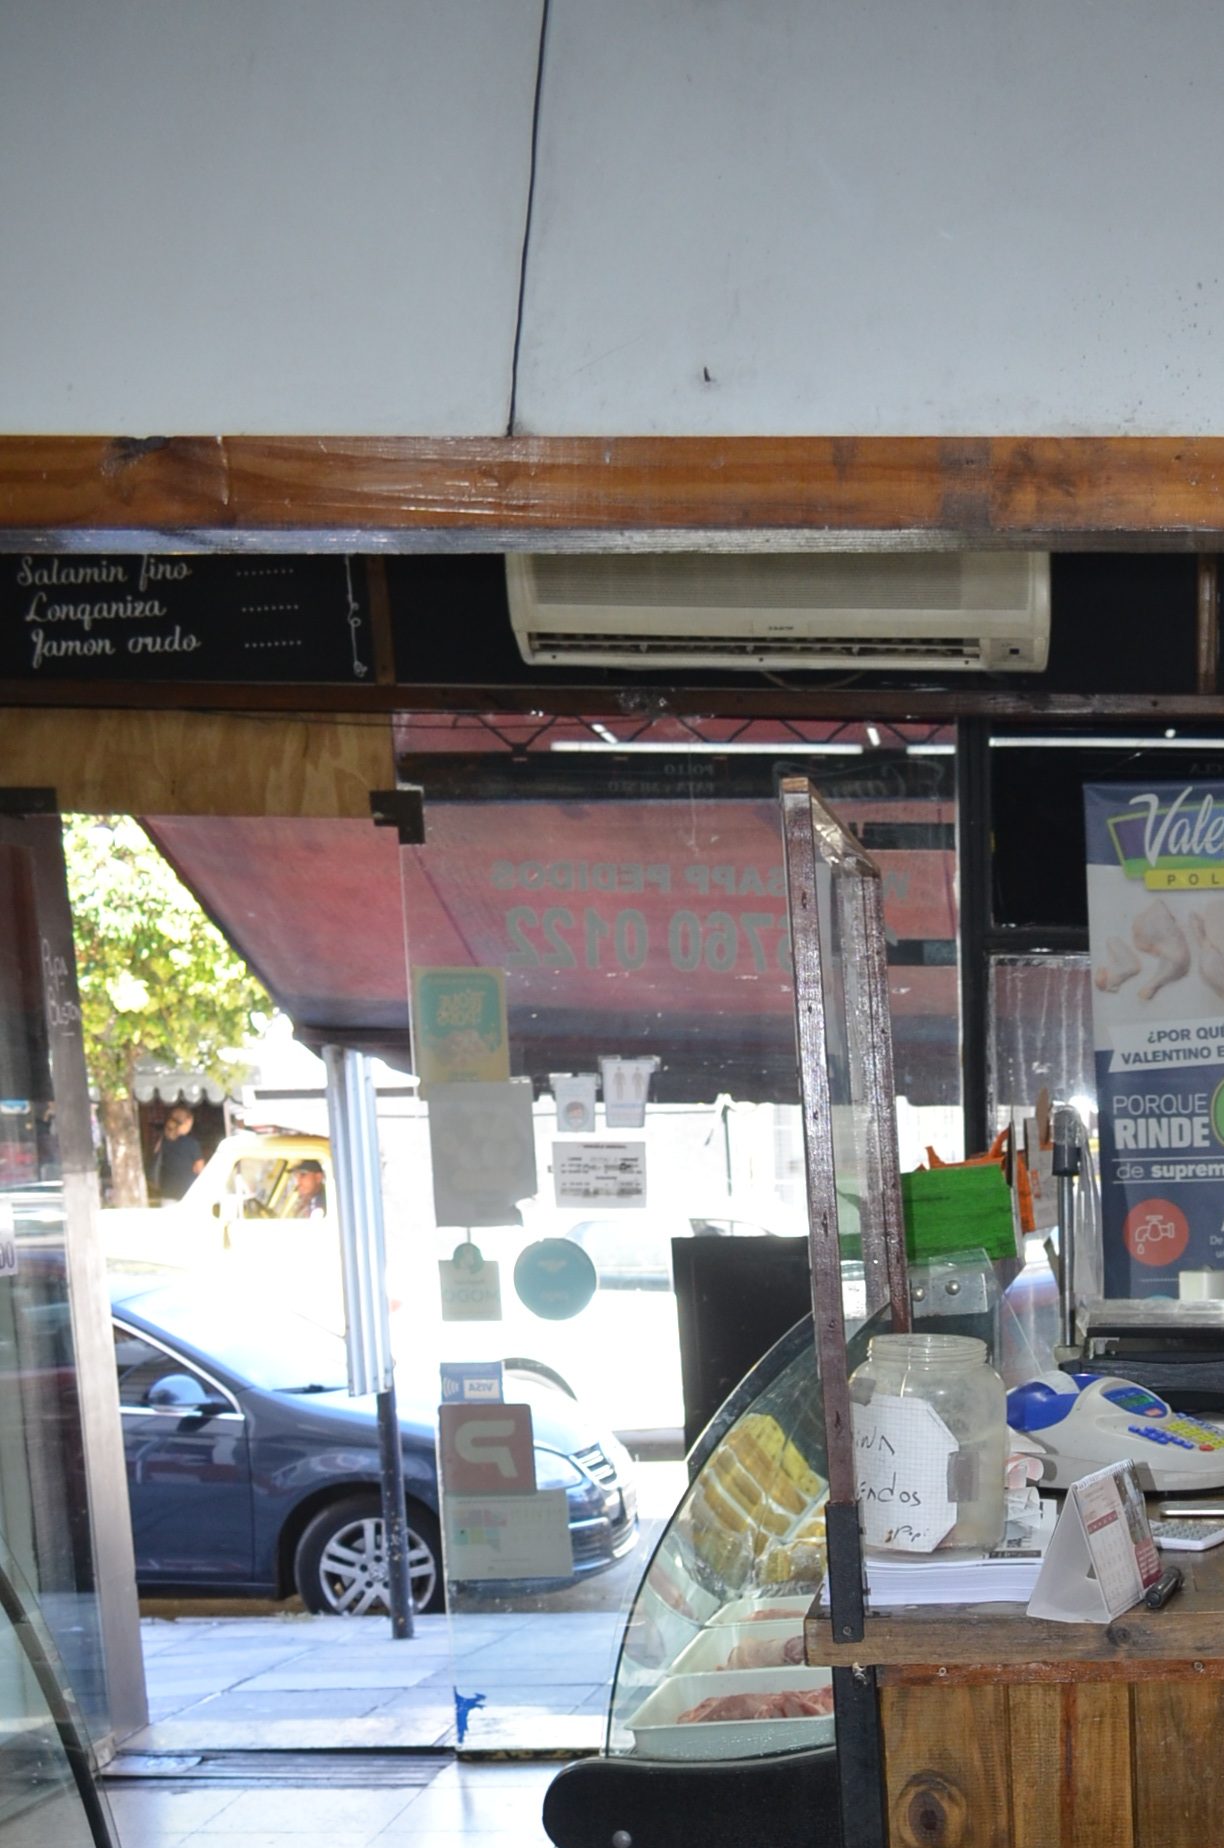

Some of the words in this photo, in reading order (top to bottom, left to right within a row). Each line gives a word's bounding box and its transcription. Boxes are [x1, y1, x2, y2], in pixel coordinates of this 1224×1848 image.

[17, 555, 127, 586] Salamin
[139, 554, 192, 592] fino
[25, 592, 167, 631] Longaniza
[31, 629, 115, 669] Jamon
[128, 625, 201, 653] crudo
[1147, 1028, 1192, 1045] ¿POR
[1121, 1046, 1212, 1066] VALENTINO
[1112, 1093, 1209, 1116] PORQUE
[1113, 1116, 1210, 1150] RINDE
[1116, 1162, 1145, 1179] de
[1209, 1235, 1224, 1246] De
